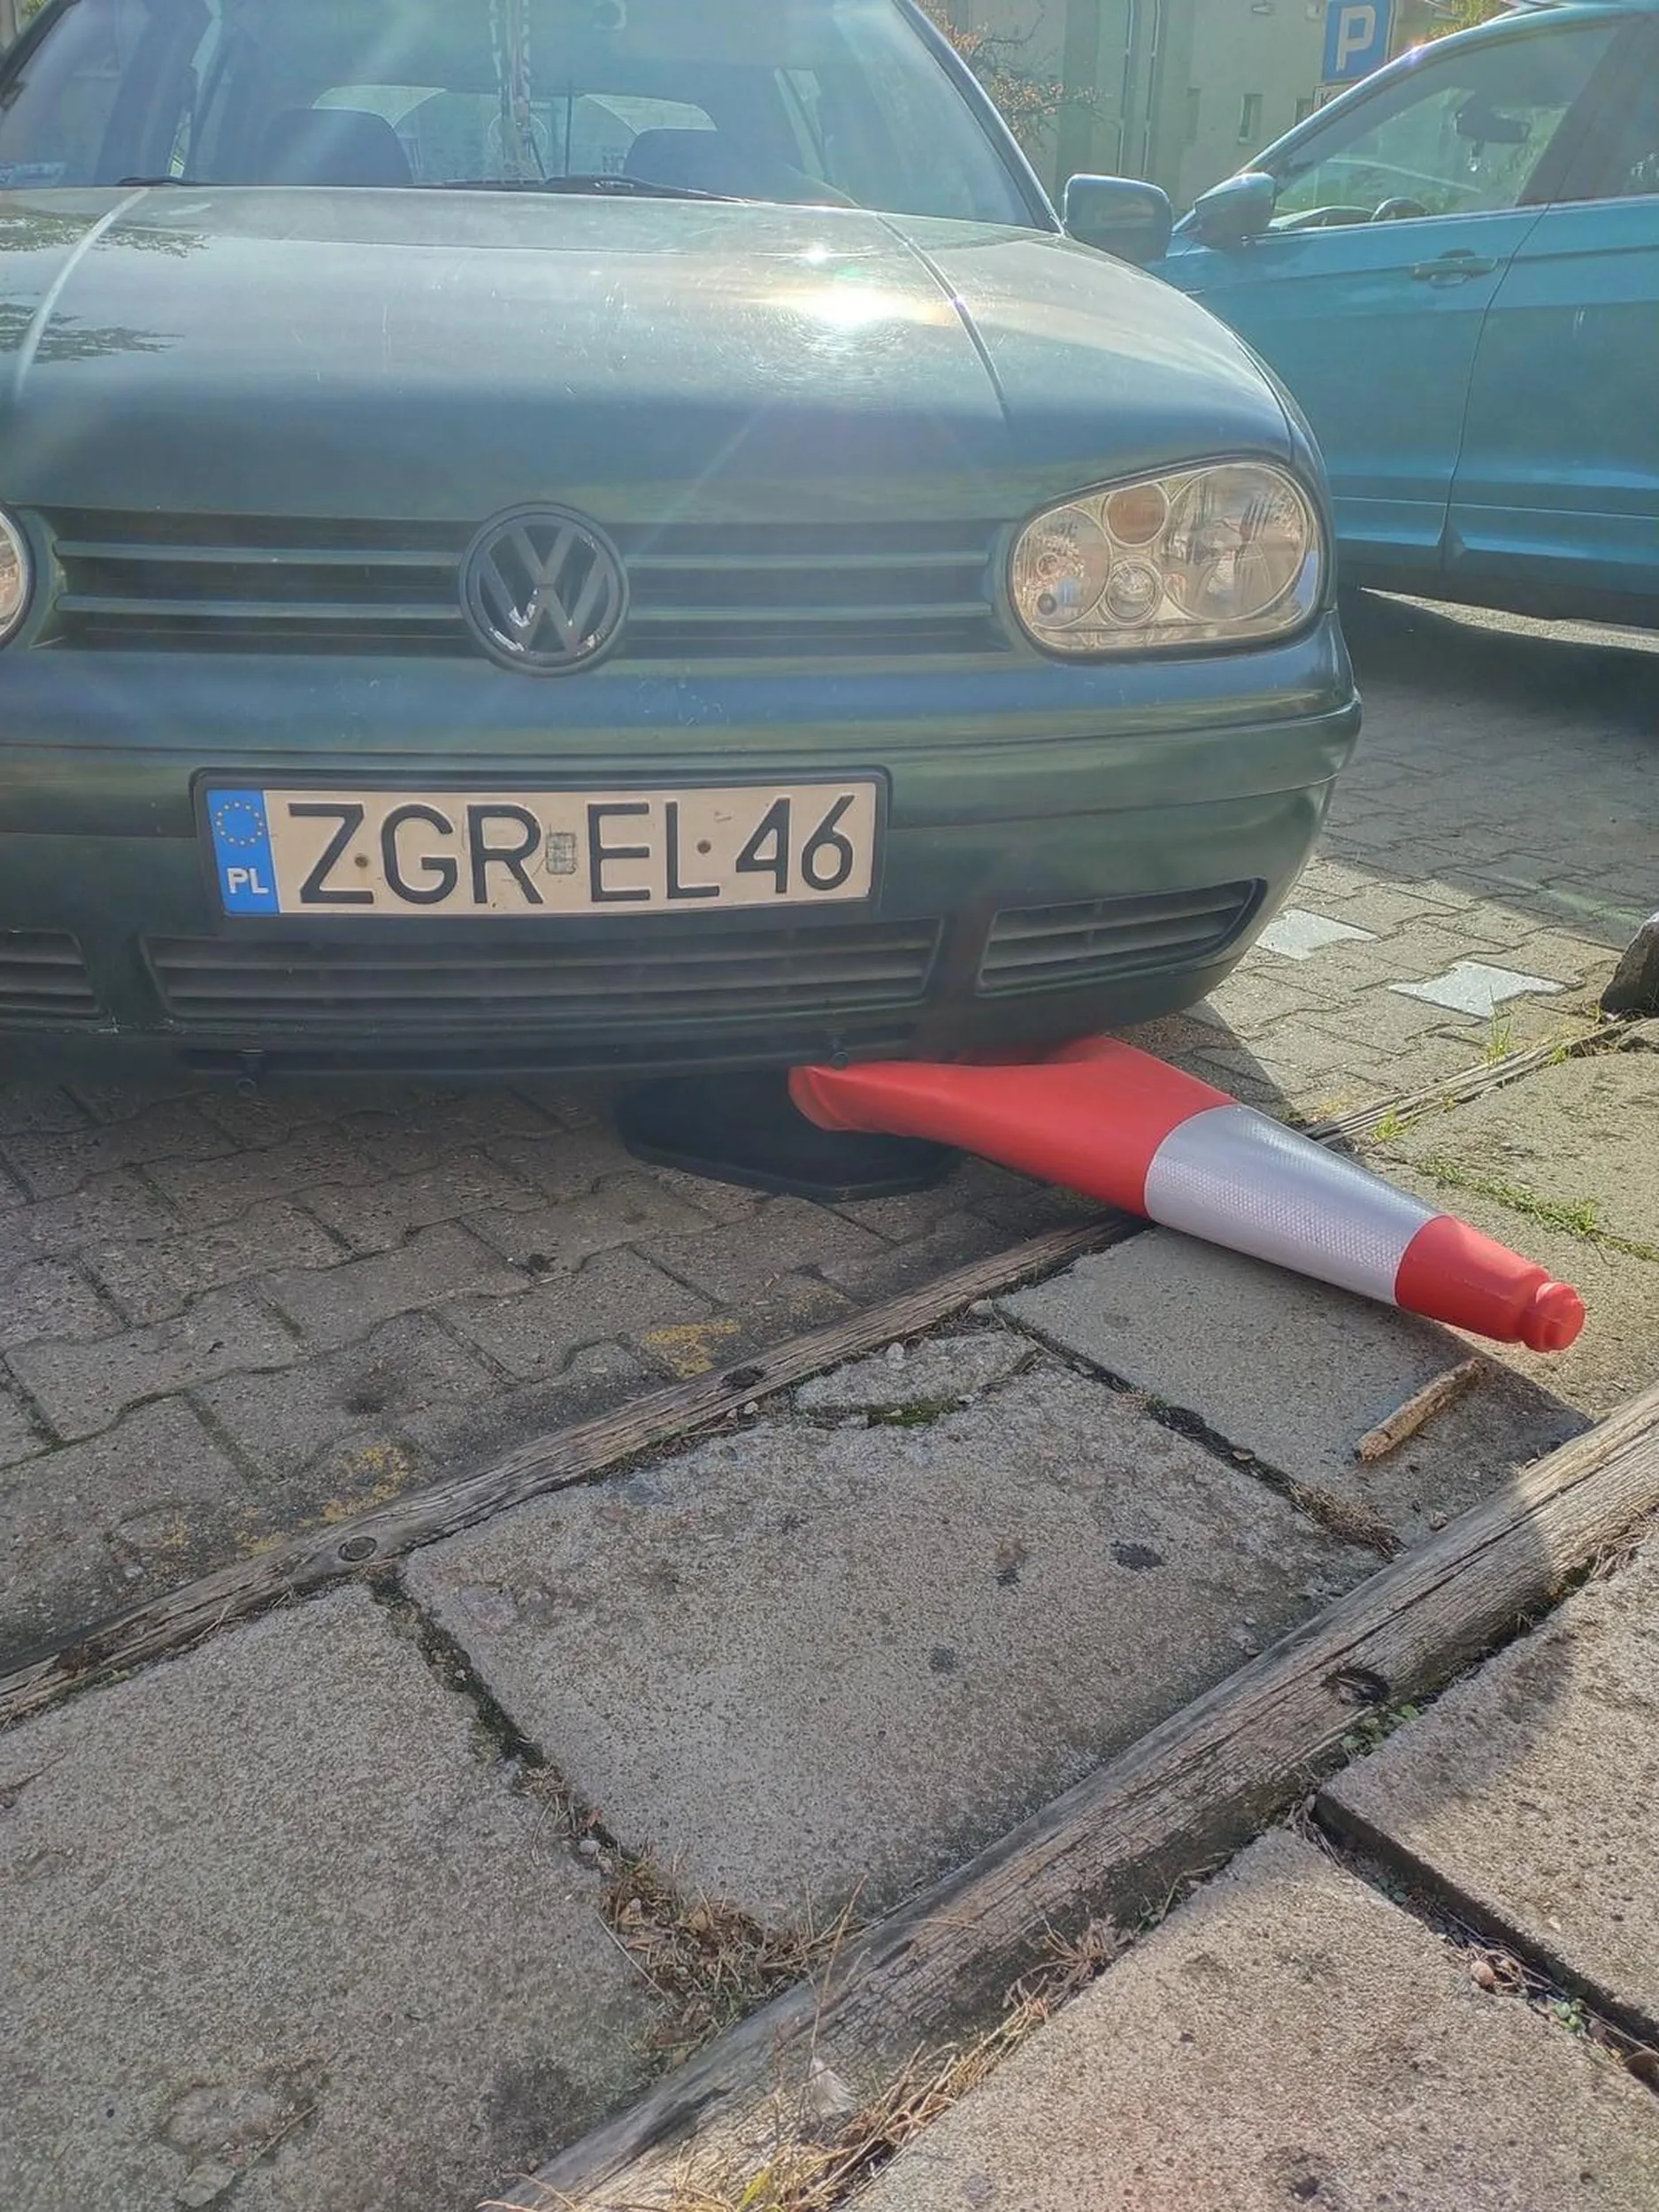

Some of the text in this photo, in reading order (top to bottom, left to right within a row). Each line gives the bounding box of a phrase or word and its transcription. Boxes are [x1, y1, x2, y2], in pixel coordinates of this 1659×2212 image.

[1336, 5, 1376, 72] P
[227, 868, 269, 894] PL
[288, 803, 543, 904] ZGR
